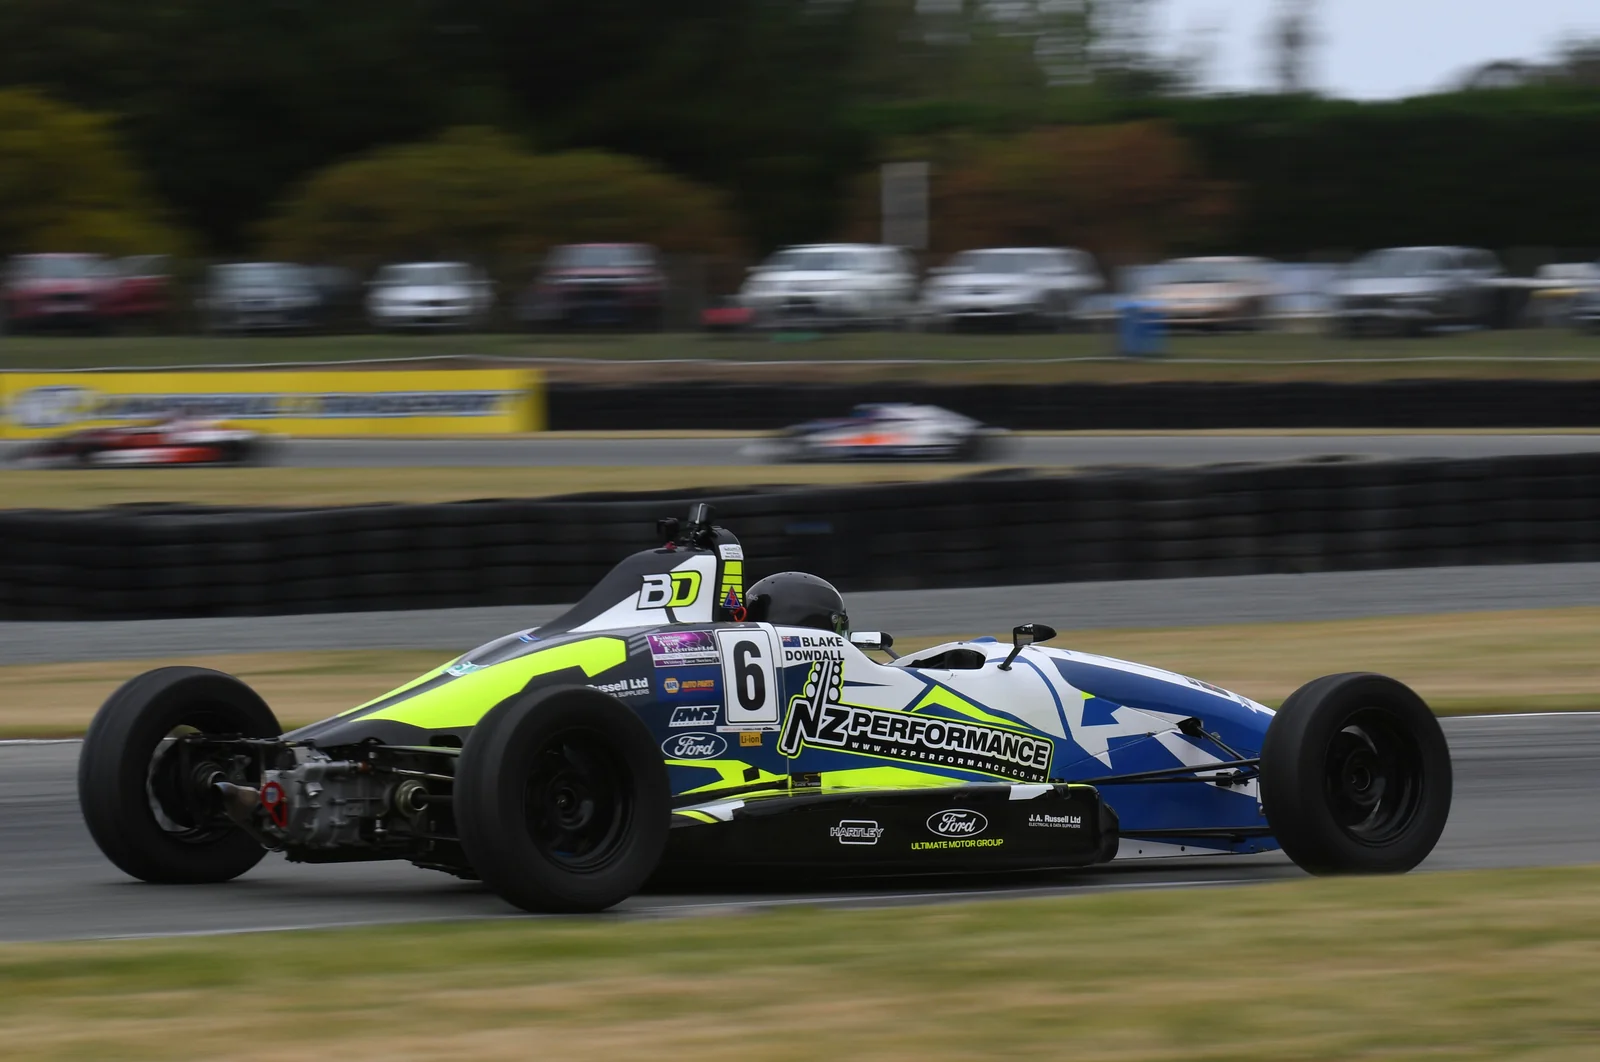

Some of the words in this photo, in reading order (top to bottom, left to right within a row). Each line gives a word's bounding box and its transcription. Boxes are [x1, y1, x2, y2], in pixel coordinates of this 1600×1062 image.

[636, 570, 702, 610] BD
[801, 636, 844, 648] BLAKE
[784, 650, 845, 661] DOWDALL
[733, 640, 766, 711] 6
[629, 677, 649, 689] Ltd
[618, 689, 650, 697] SUPPLIERS
[674, 735, 716, 756] Ford
[851, 741, 1045, 782] WWW.NZPERFORMANCE.CO.NZ
[938, 812, 977, 833] Ford
[1044, 814, 1069, 823] Russell
[1070, 815, 1081, 824] Ltd
[829, 826, 885, 838] HARTLEY
[910, 841, 948, 850] ULTIMATE
[948, 839, 976, 848] MOTOR
[976, 838, 1004, 847] GROUP
